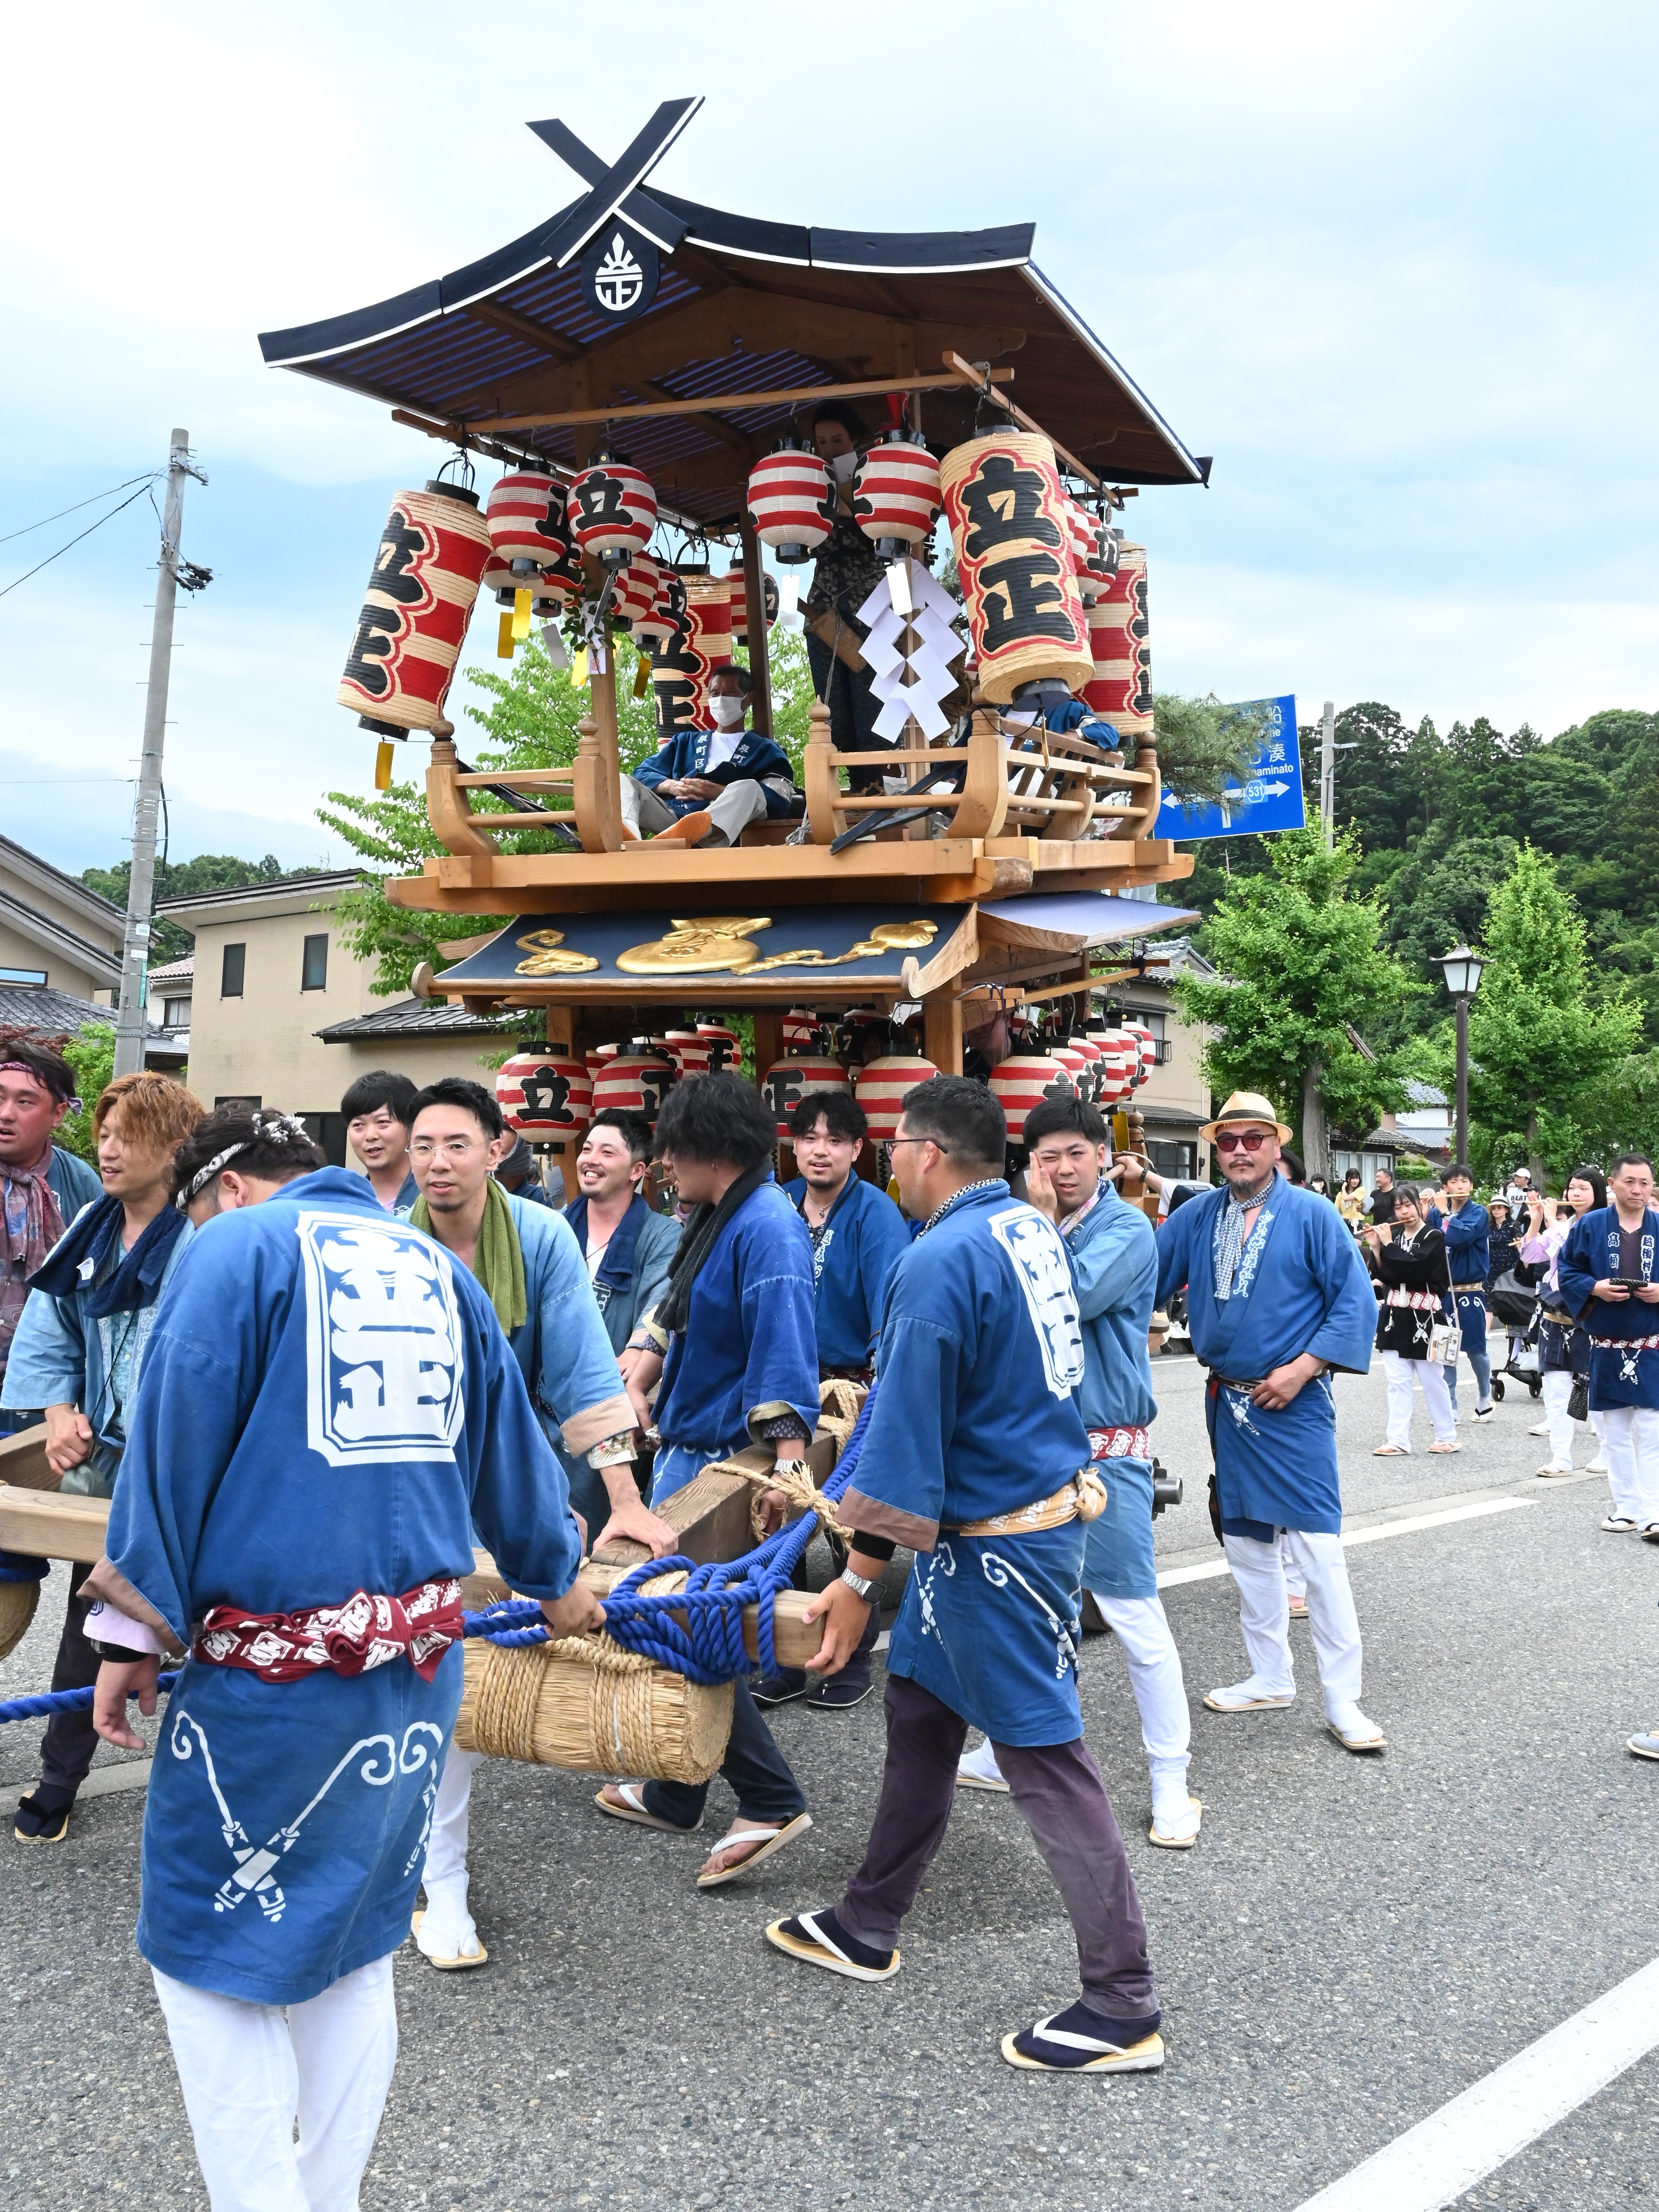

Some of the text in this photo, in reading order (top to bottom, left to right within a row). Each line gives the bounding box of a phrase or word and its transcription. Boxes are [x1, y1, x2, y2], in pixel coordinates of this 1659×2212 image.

[576, 470, 633, 531] 立
[961, 456, 1076, 653] 立正
[1248, 786, 1263, 798] 531
[516, 1066, 574, 1123] 立
[1608, 1232, 1619, 1269] 高橋
